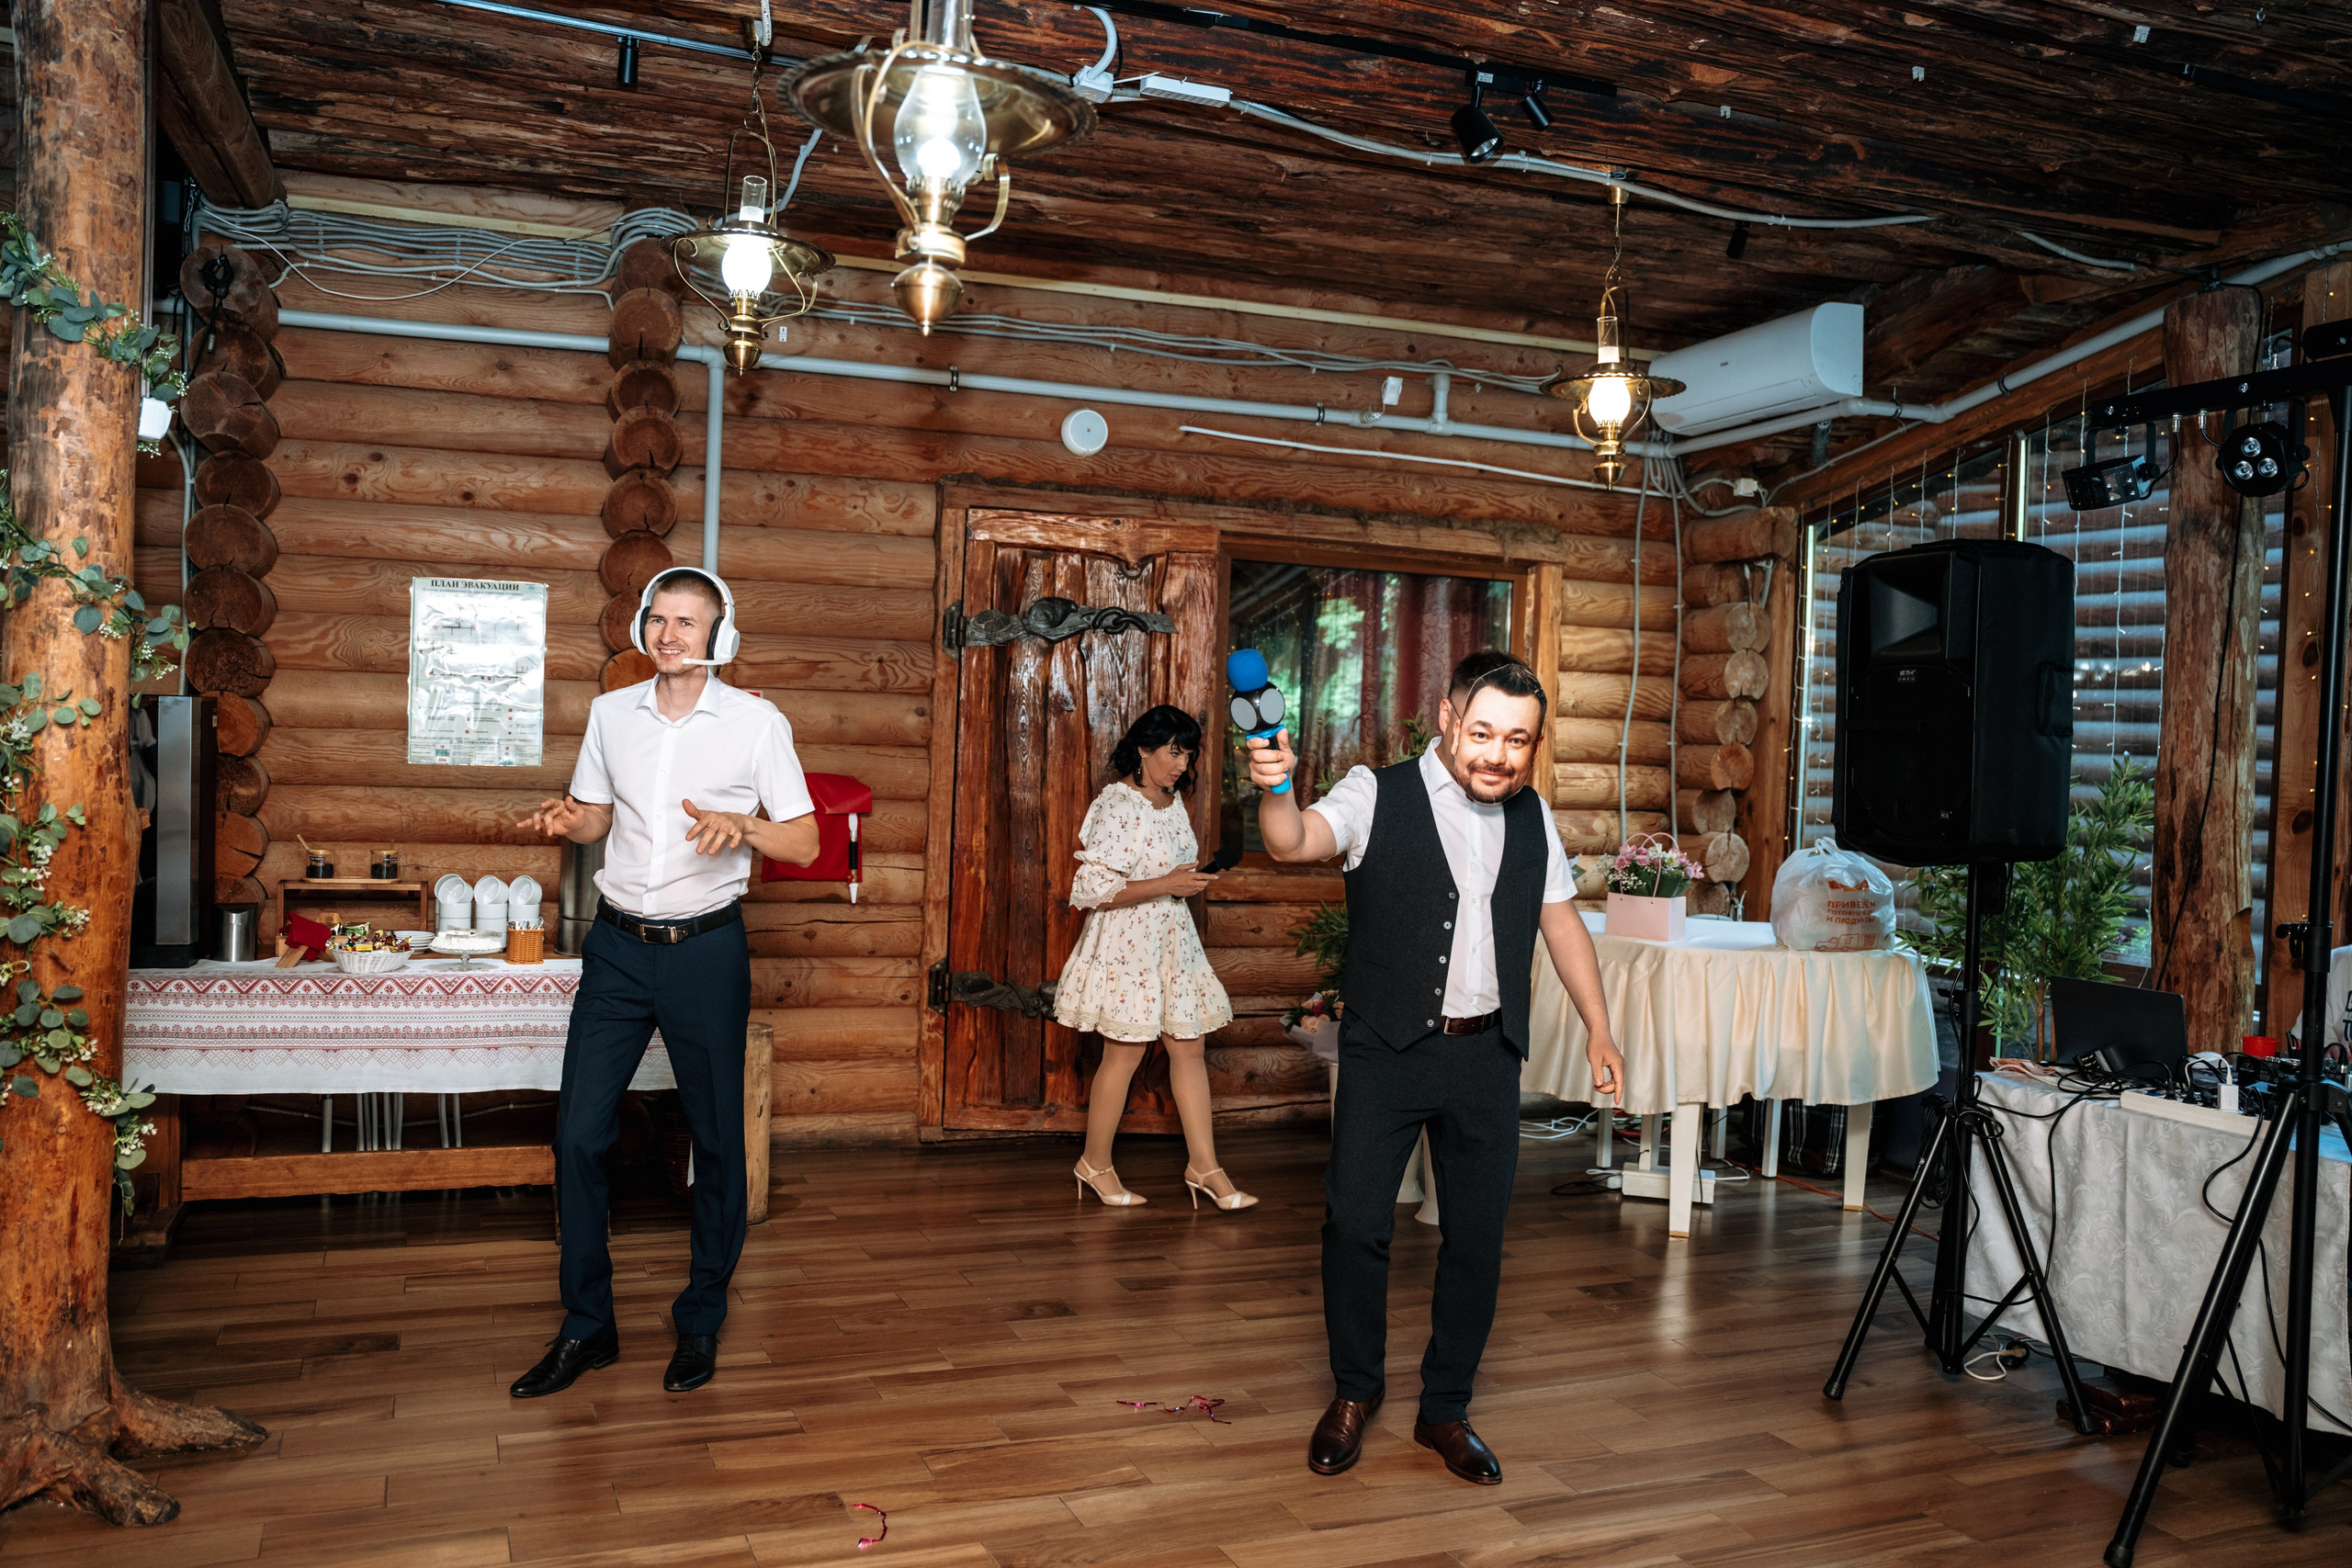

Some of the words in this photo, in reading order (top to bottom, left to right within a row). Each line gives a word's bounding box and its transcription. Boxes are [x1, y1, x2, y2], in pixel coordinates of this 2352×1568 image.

[431, 580, 459, 588] ПЛАН
[461, 581, 519, 592] ЭВАКУАЦИИ
[1835, 916, 1875, 925] ПРОДУКТЫ
